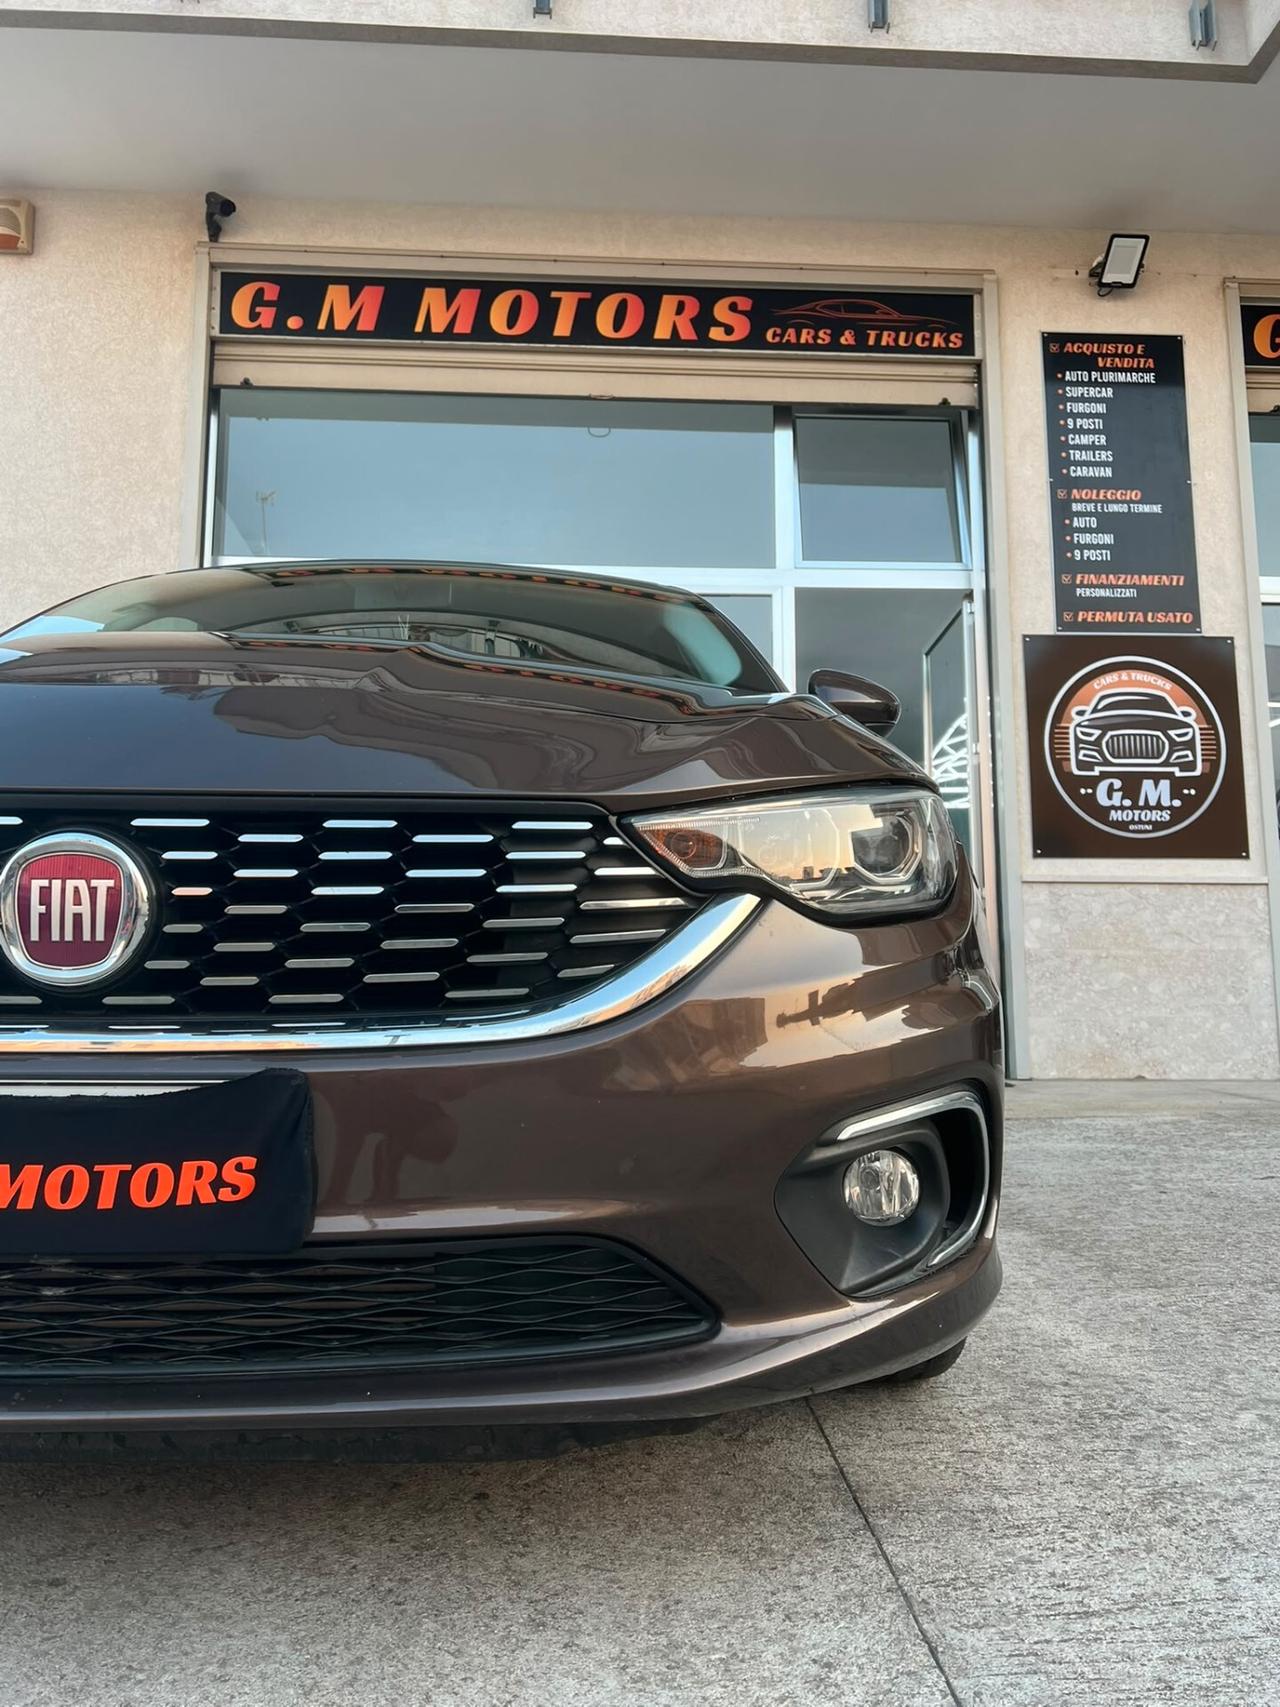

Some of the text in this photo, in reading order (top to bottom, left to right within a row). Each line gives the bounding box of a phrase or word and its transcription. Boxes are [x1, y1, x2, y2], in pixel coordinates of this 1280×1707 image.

[231, 281, 754, 343] G.M MOTORS
[766, 327, 964, 349] CARS & TRUCKS
[1064, 343, 1145, 355] ACQUISTO E
[1097, 357, 1155, 369] VENDITA
[1065, 371, 1156, 384] AUTO PLURIMARCHE
[1065, 387, 1114, 399] SUPERCAR
[1066, 402, 1107, 414] FURGONI
[1067, 418, 1103, 430] 9 POSTI
[1068, 434, 1107, 446] CAMPER
[1069, 450, 1114, 462] TRAILERS
[1070, 466, 1113, 478] CARAVAN
[1071, 489, 1142, 500] NOLEGGIO
[1072, 502, 1163, 514] BREVE E LUNGO TERMINE
[1073, 516, 1097, 528] AUTO
[1073, 533, 1115, 545] FURGONI
[1074, 549, 1111, 561] 9 POSTI
[1075, 574, 1185, 586] FINANZIAMENTI
[1076, 588, 1137, 597] PERSONALIZZATI
[1077, 611, 1194, 623] PERMUTA USATO
[1093, 673, 1119, 689] CARS
[1131, 672, 1173, 691] TRUCKS
[1096, 778, 1182, 808] G. M.
[1109, 809, 1171, 822] MOTORS
[30, 878, 115, 943] FIAT
[0, 1155, 258, 1210] MOTORS
